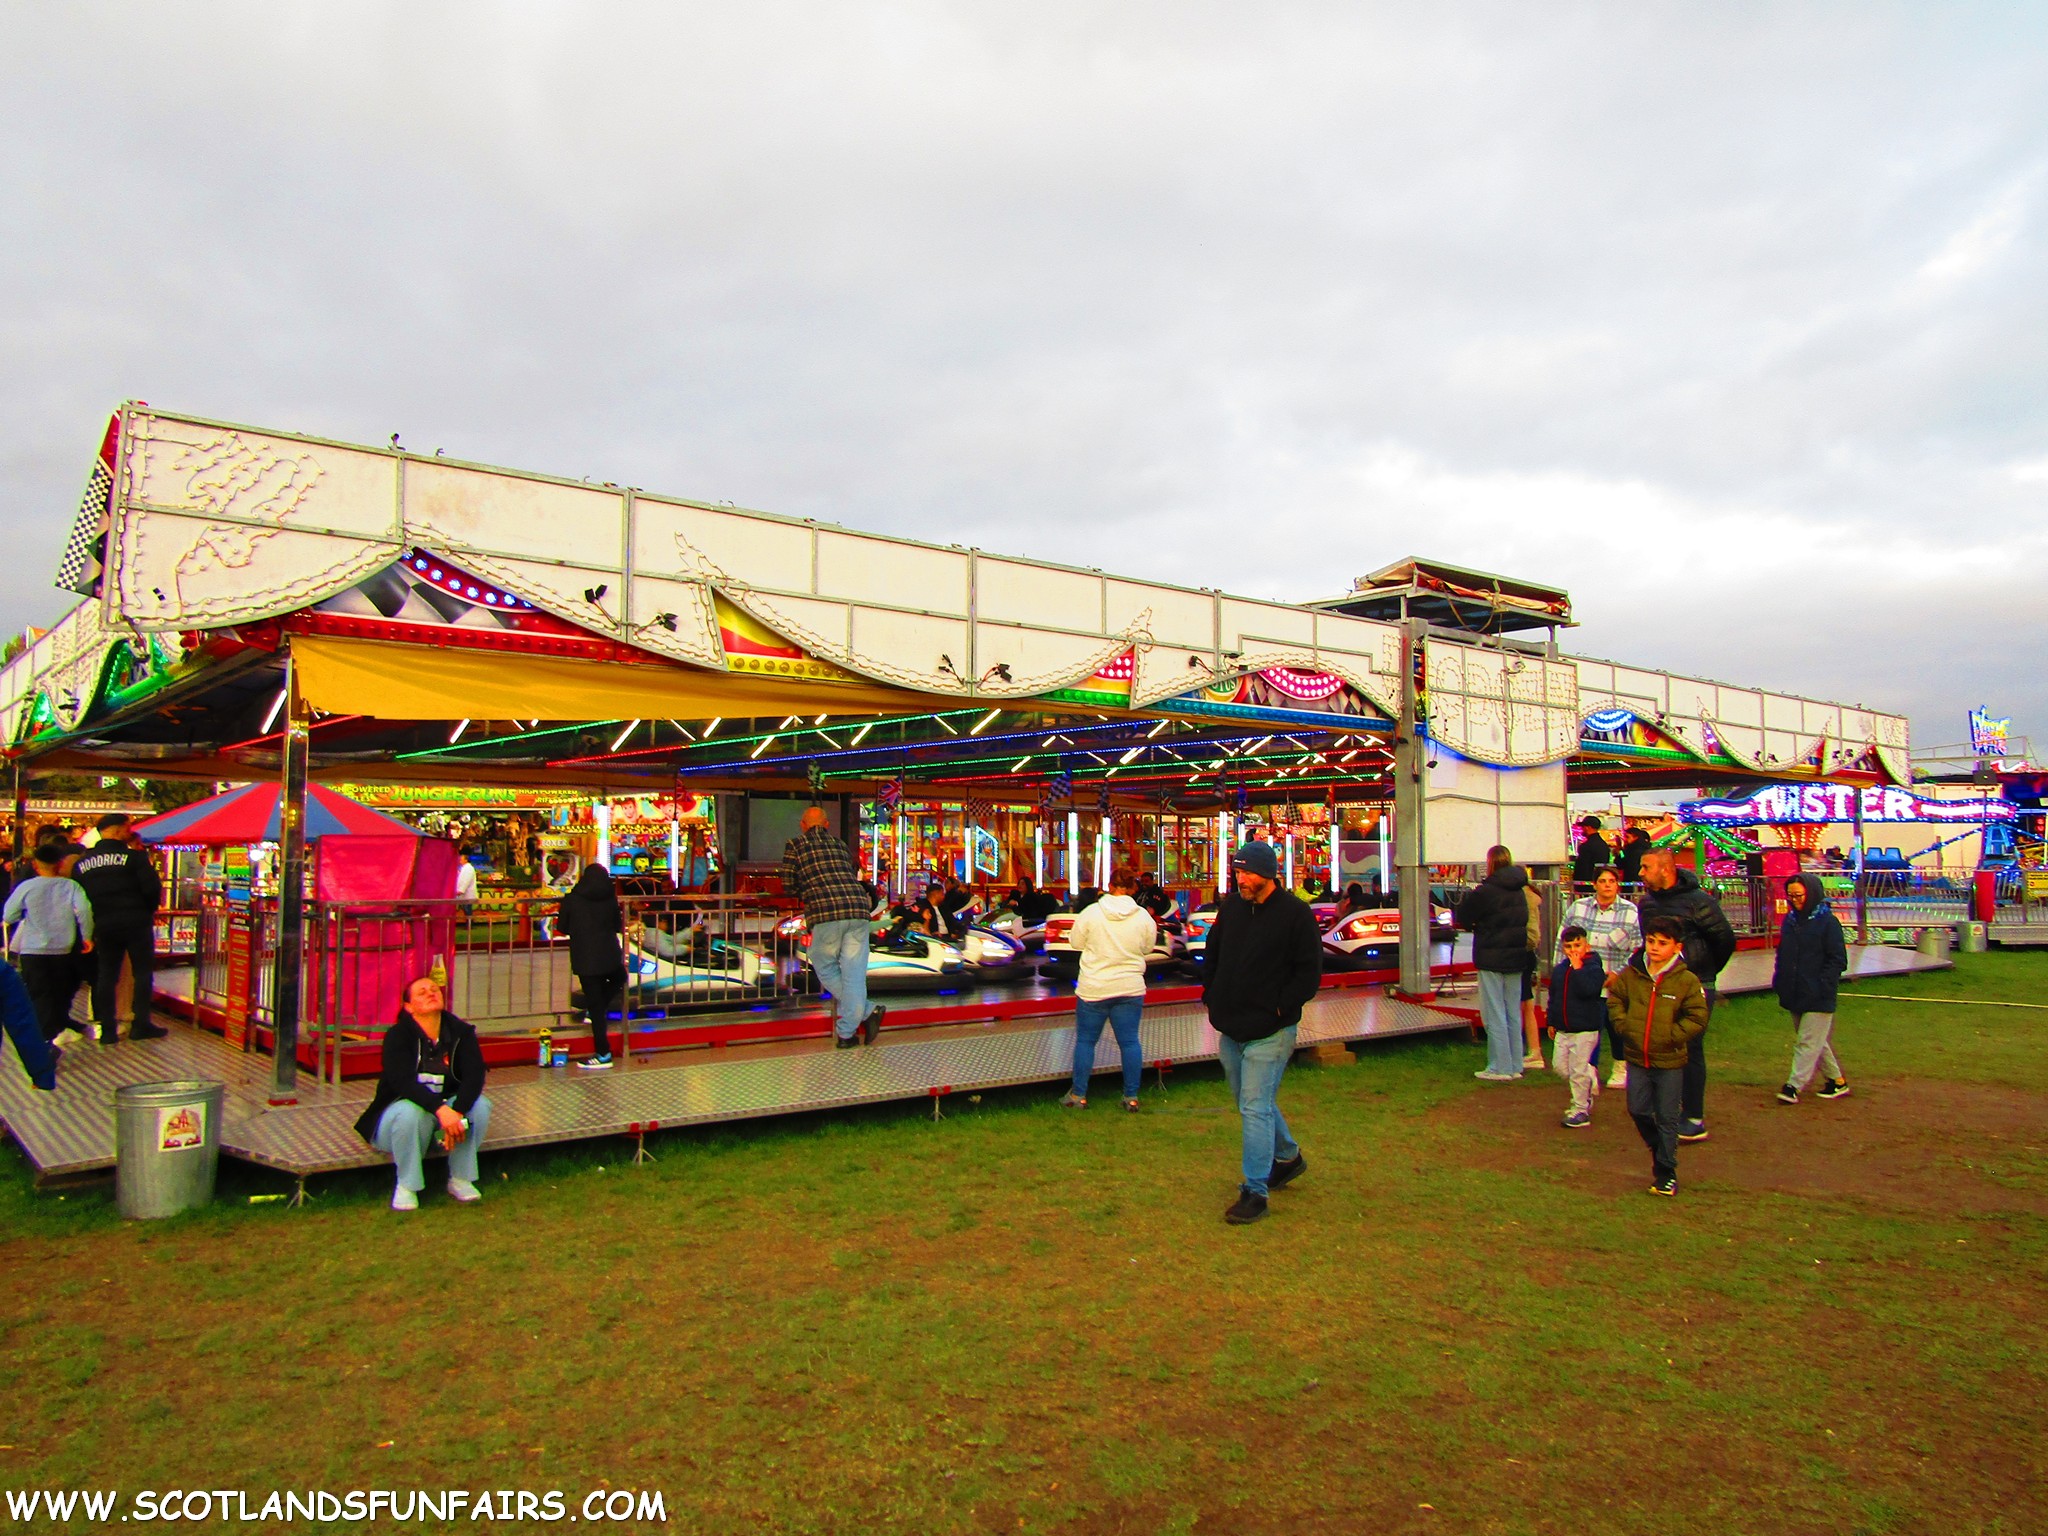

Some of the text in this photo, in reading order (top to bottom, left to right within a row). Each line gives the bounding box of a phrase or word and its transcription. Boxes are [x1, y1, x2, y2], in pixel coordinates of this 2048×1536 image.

[391, 785, 517, 802] JUNGLE GUNS
[1752, 785, 1915, 819] TWISTER
[78, 853, 129, 875] HOODRICH
